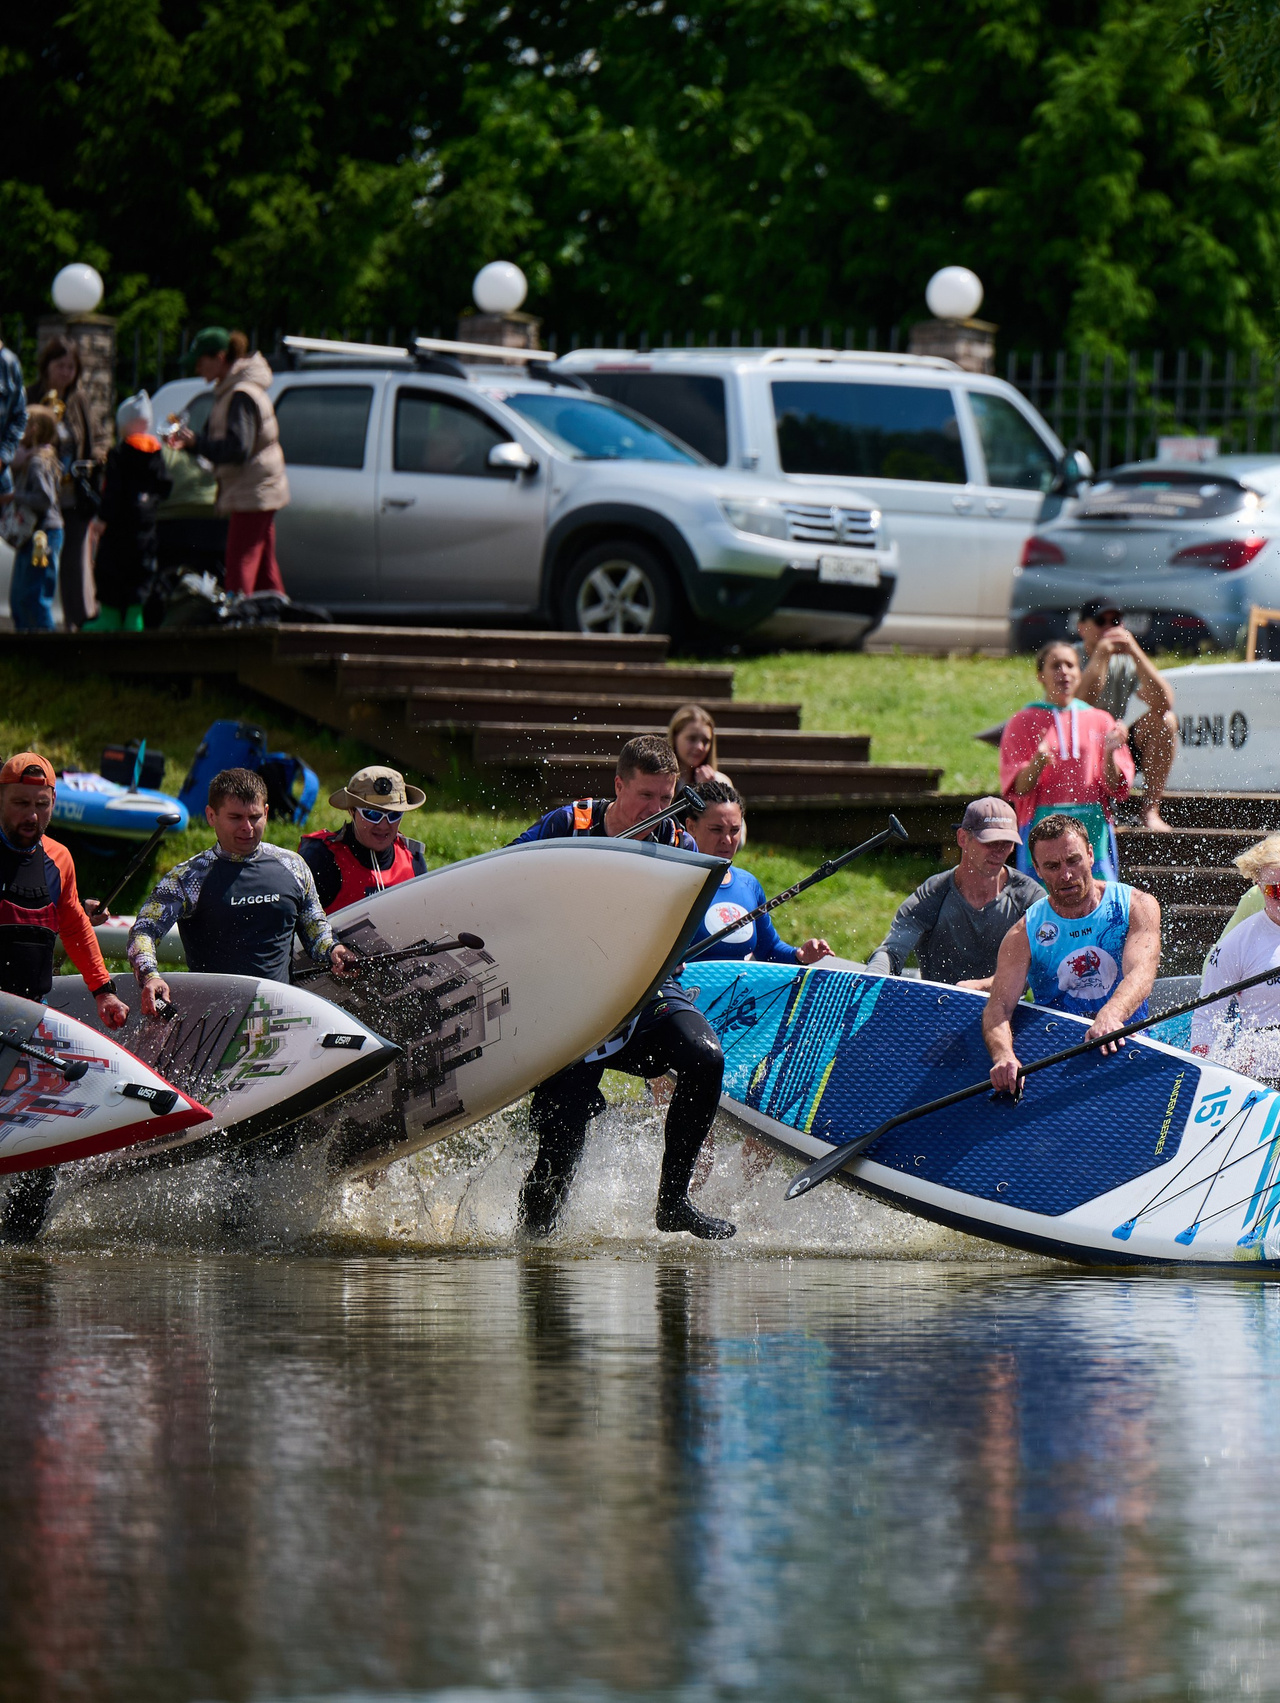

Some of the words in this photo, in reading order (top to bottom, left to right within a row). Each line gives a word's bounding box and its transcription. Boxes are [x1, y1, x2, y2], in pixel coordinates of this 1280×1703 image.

[758, 882, 801, 914] AQUA
[1069, 931, 1080, 939] 40
[1081, 927, 1093, 936] KM
[1165, 1071, 1185, 1117] TANDEM
[1154, 1117, 1172, 1156] SERIES
